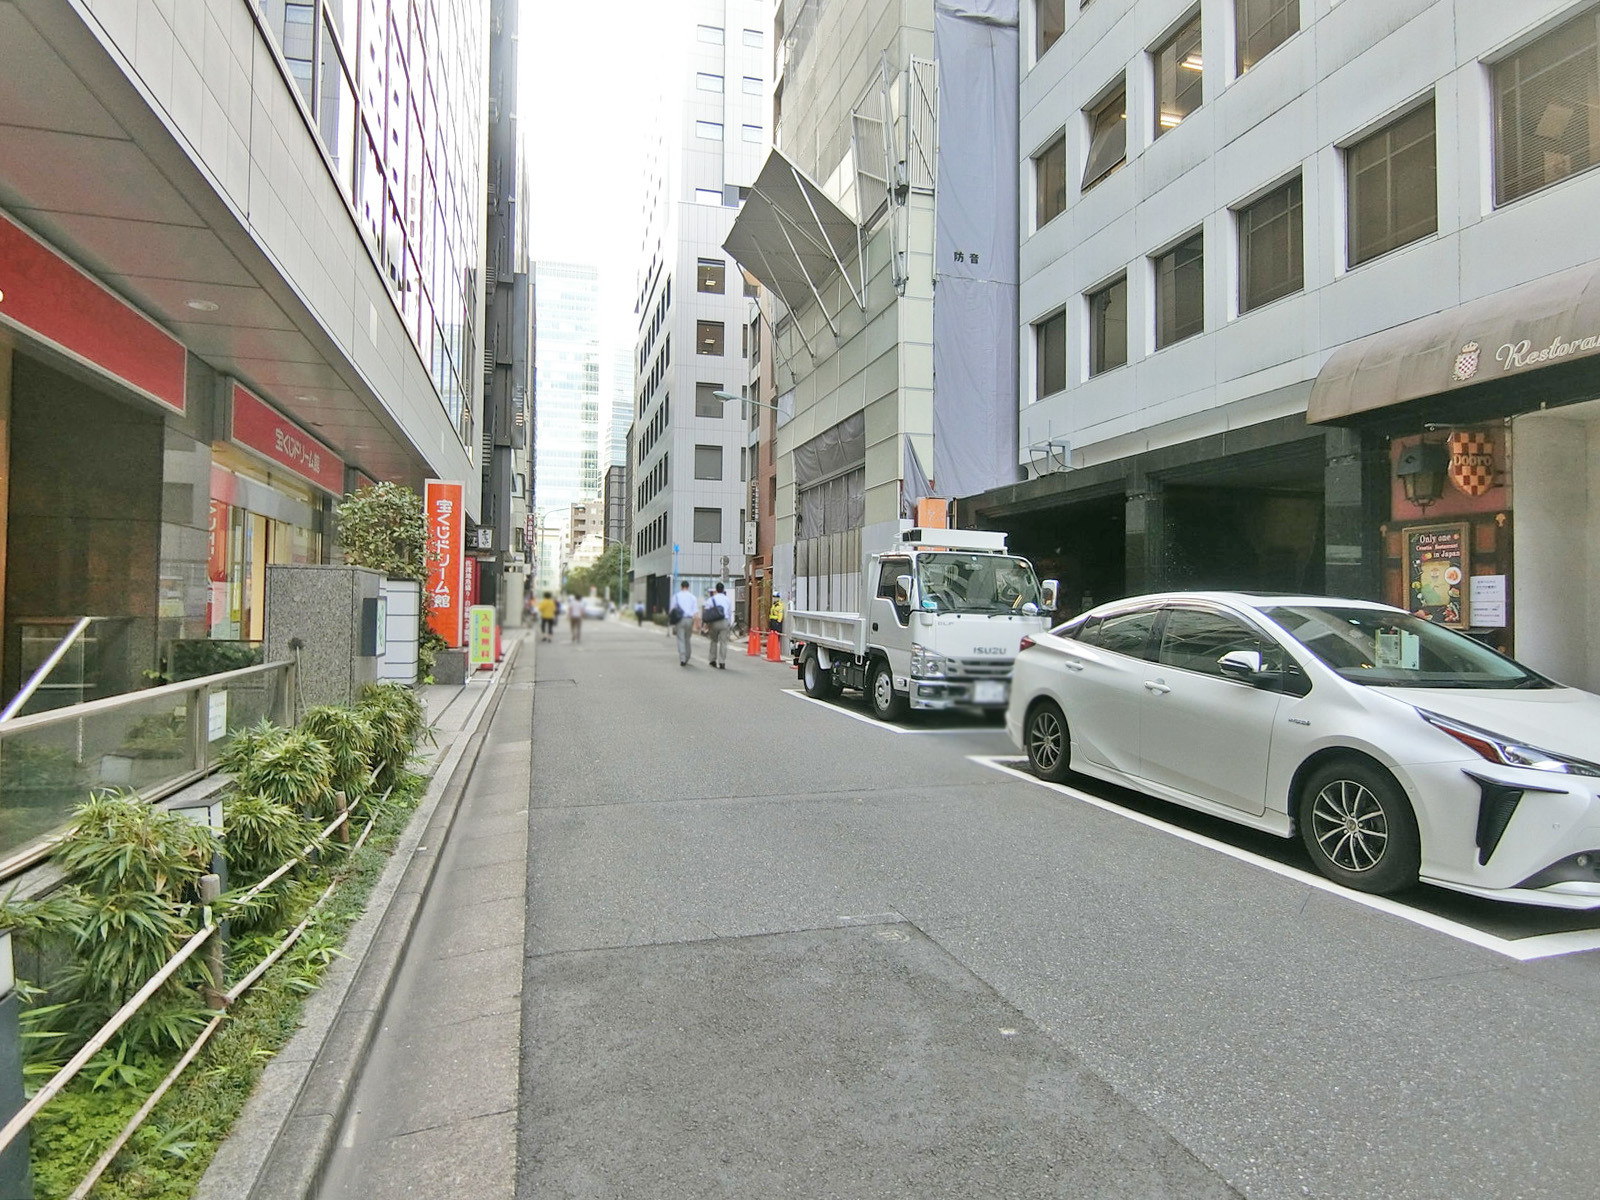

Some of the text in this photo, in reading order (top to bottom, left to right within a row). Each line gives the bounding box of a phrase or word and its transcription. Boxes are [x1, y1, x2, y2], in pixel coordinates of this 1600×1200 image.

[953, 251, 979, 265] 防音
[275, 428, 320, 474] 宝くじドリーム館
[1420, 534, 1436, 544] Only
[434, 499, 453, 608] 宝くじドリーム館
[1441, 550, 1460, 558] Japan
[973, 646, 1007, 655] ISUZU
